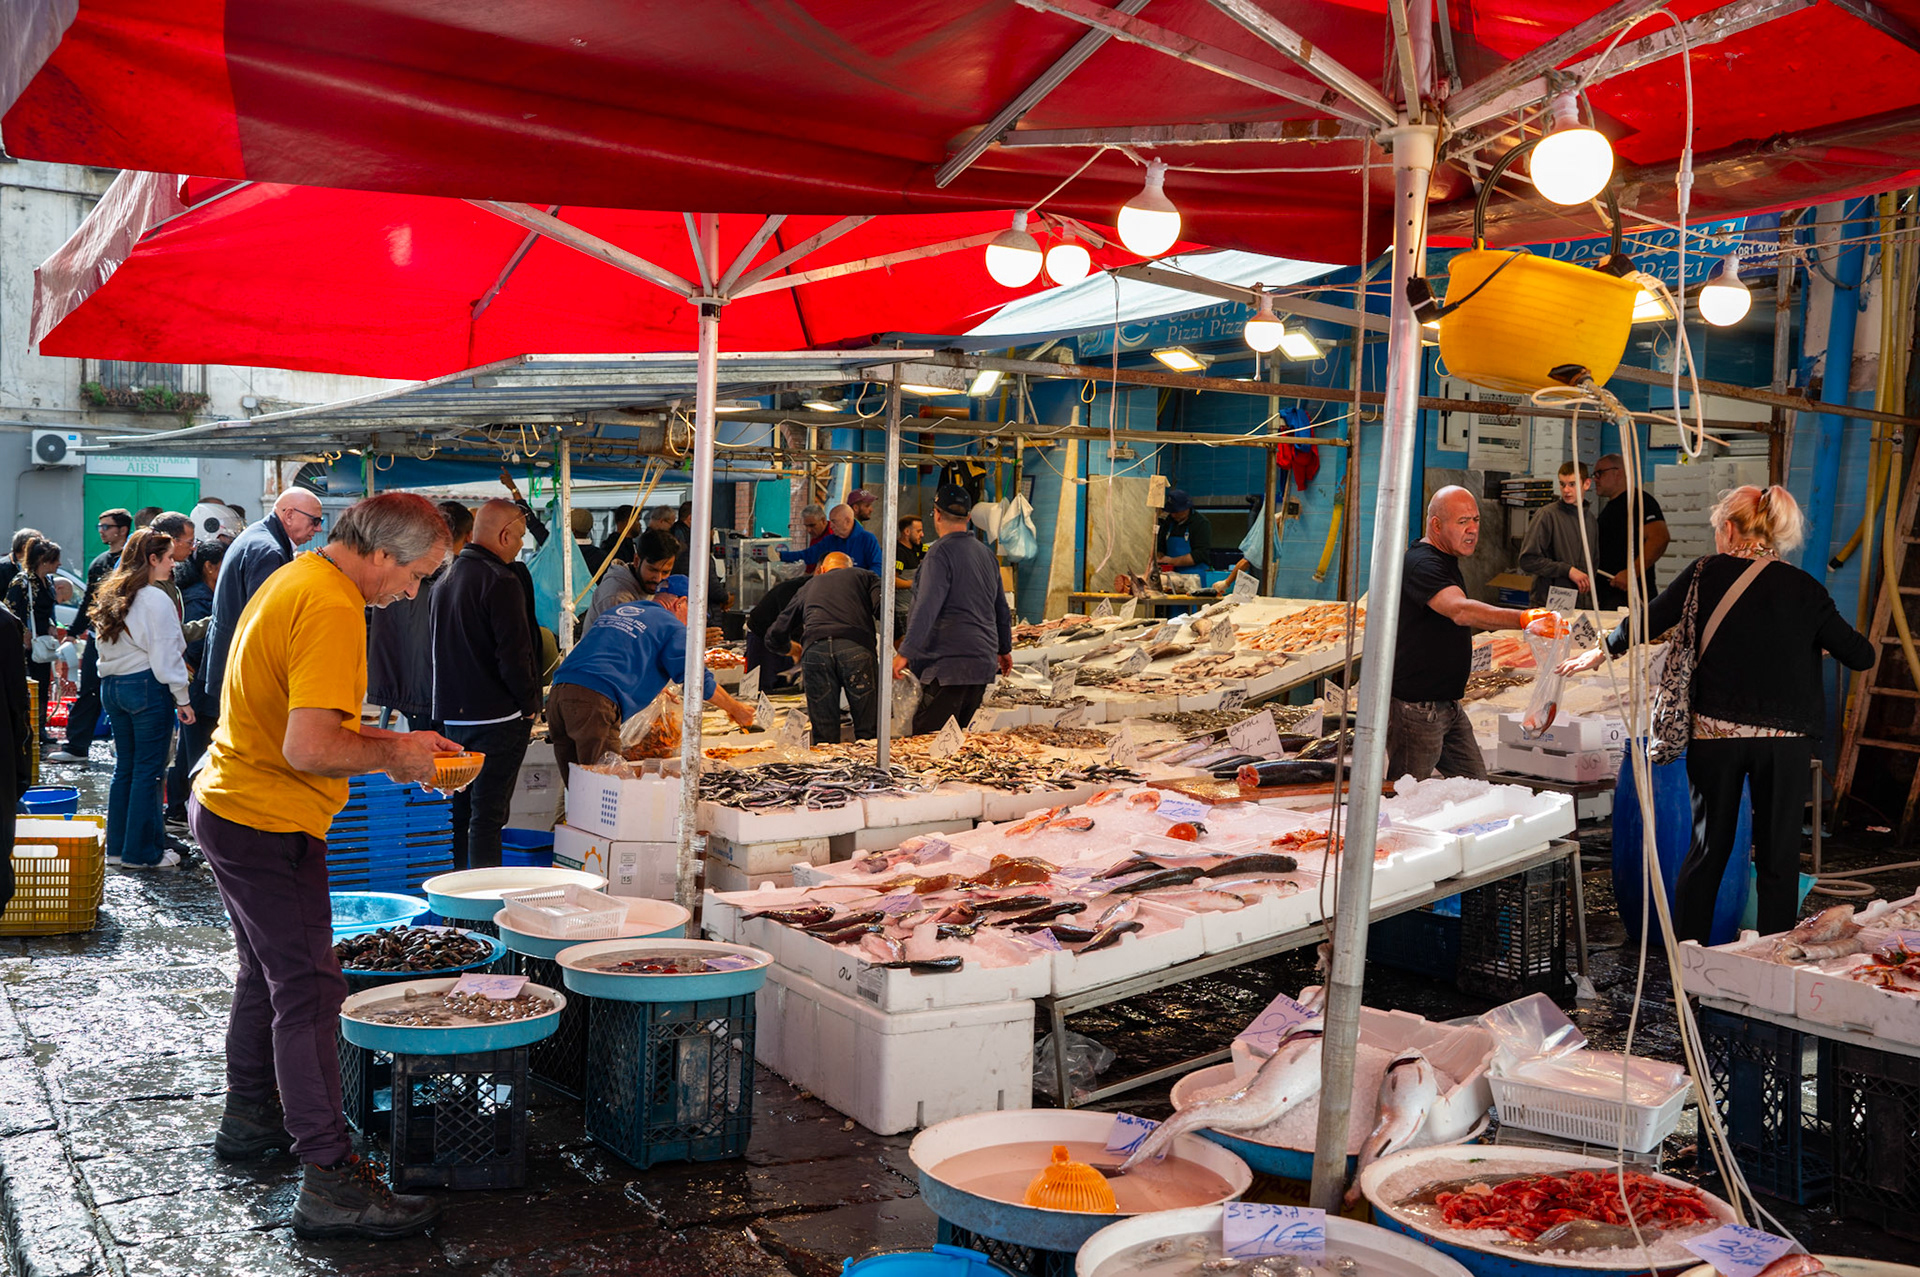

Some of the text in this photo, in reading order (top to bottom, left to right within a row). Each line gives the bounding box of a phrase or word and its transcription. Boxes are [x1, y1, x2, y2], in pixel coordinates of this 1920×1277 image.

[1640, 261, 1704, 282] Pizzi
[1166, 317, 1247, 342] Pizzi Pizz
[126, 462, 159, 474] AIESI
[1810, 982, 1825, 1012] 5
